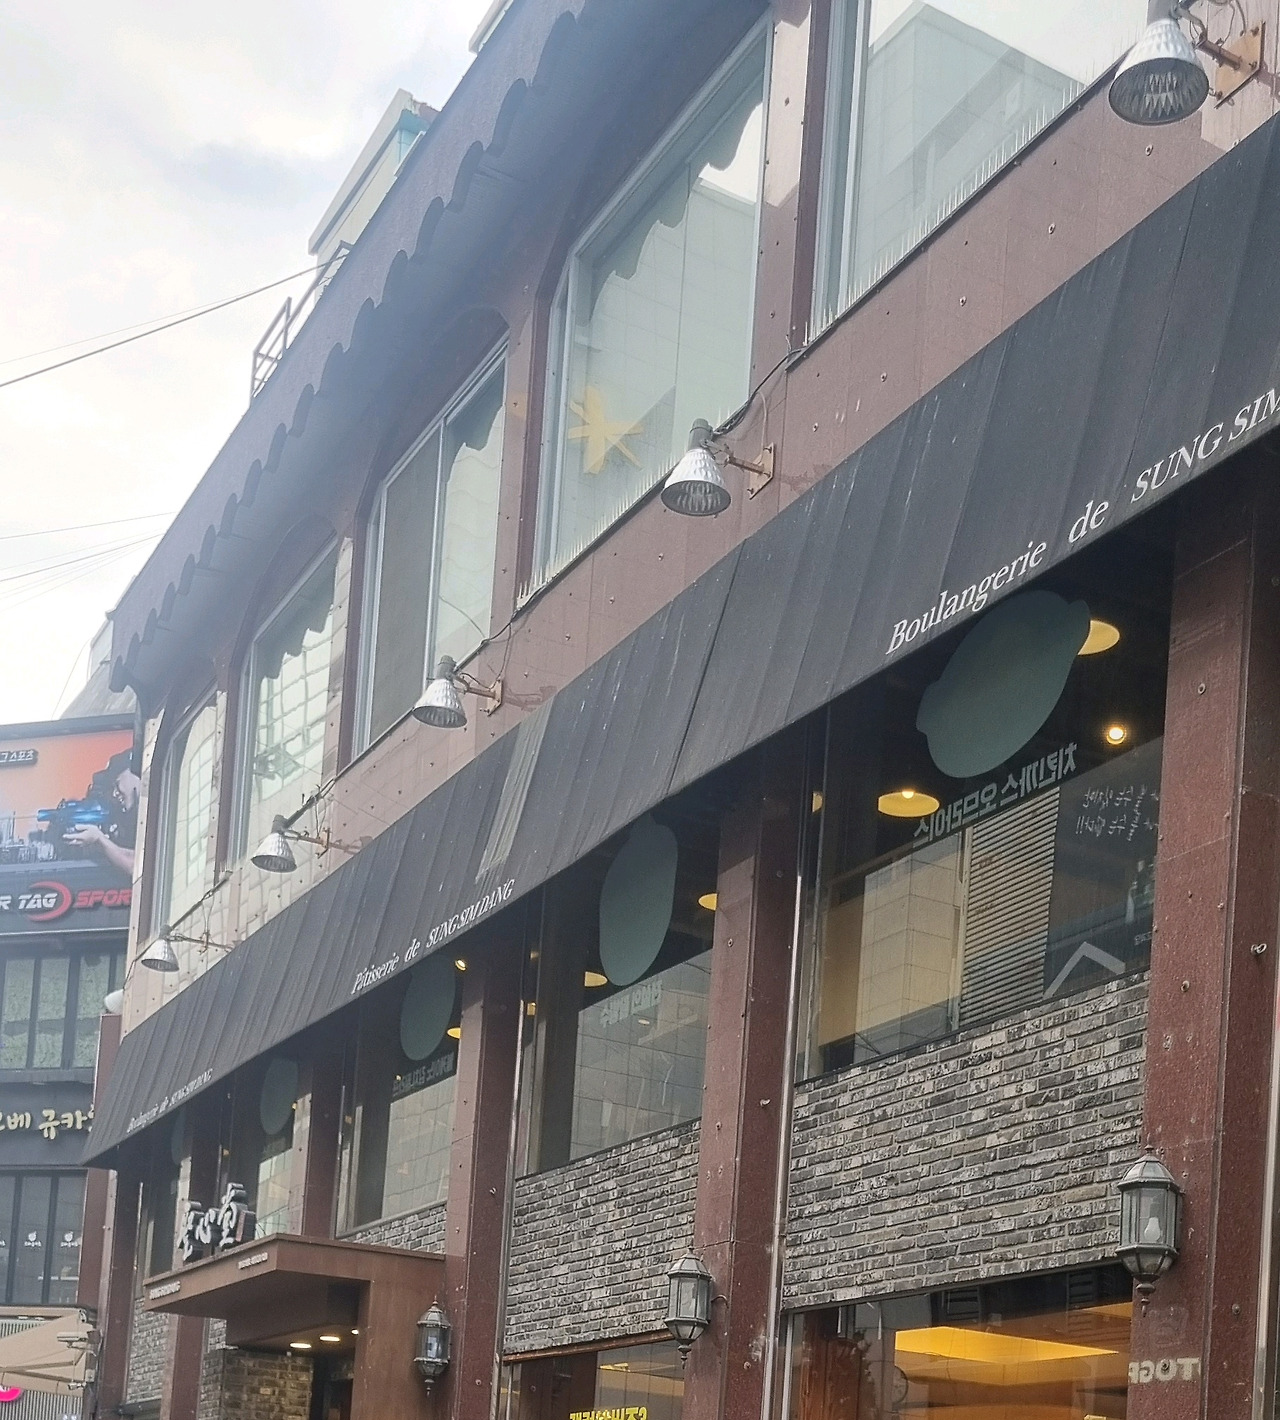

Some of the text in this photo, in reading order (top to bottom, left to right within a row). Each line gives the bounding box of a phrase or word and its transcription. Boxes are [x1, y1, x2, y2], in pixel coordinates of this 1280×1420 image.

[885, 539, 1048, 656] Boulangerie
[1067, 498, 1111, 545] de
[1130, 422, 1224, 503] SUNG
[18, 893, 58, 909] TAG
[404, 938, 421, 963] de
